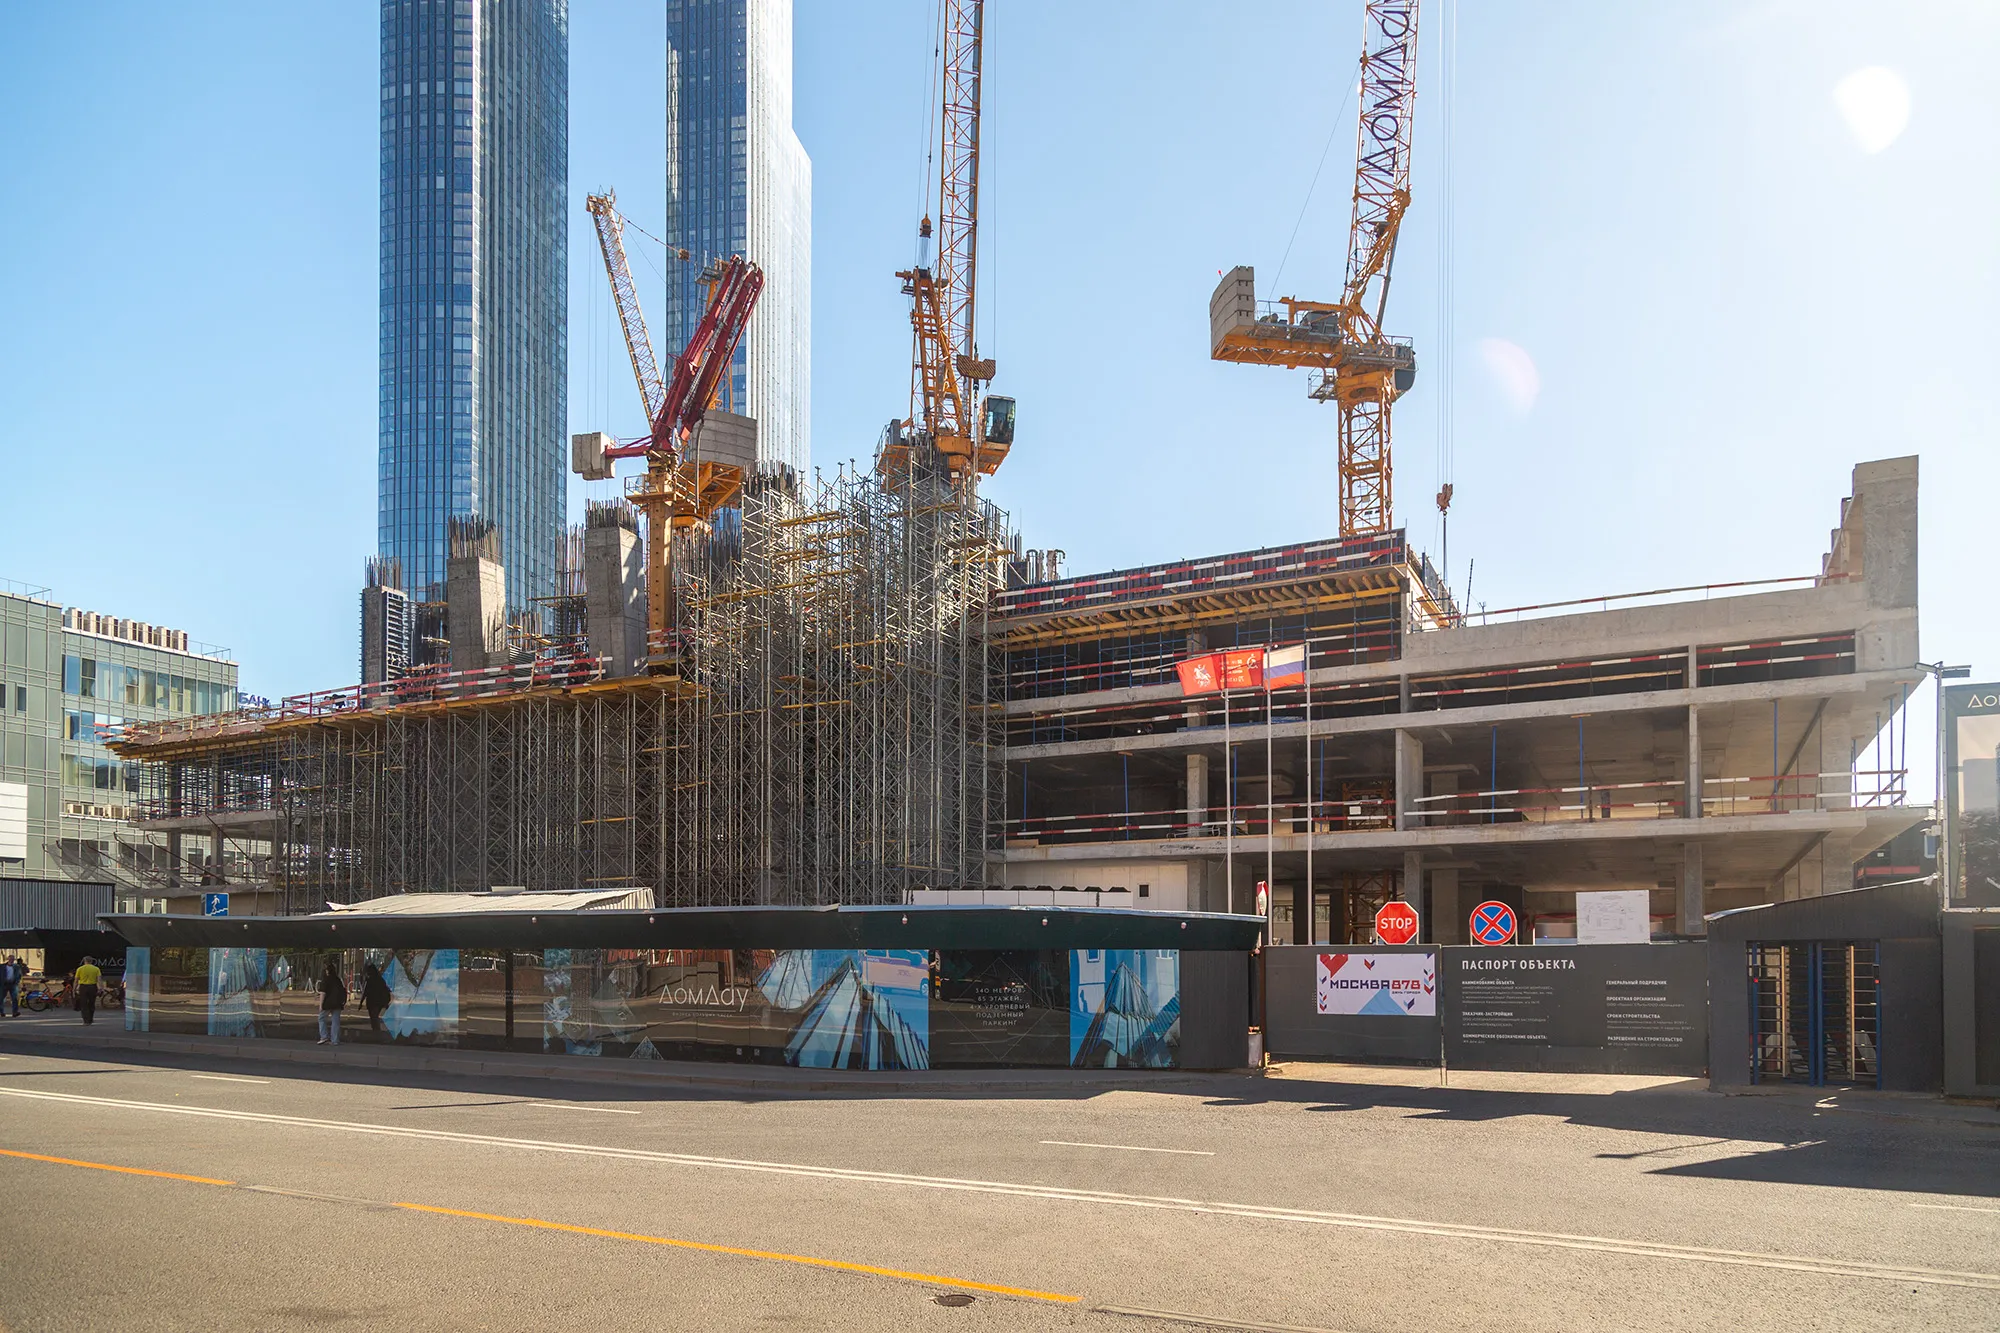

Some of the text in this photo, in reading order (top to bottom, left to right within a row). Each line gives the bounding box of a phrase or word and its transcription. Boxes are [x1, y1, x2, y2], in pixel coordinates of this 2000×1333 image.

[1381, 917, 1413, 929] STOP
[1462, 960, 1576, 970] ПАСПОРТ ОБЪЕКТА
[1330, 980, 1420, 989] МОСКВА 878
